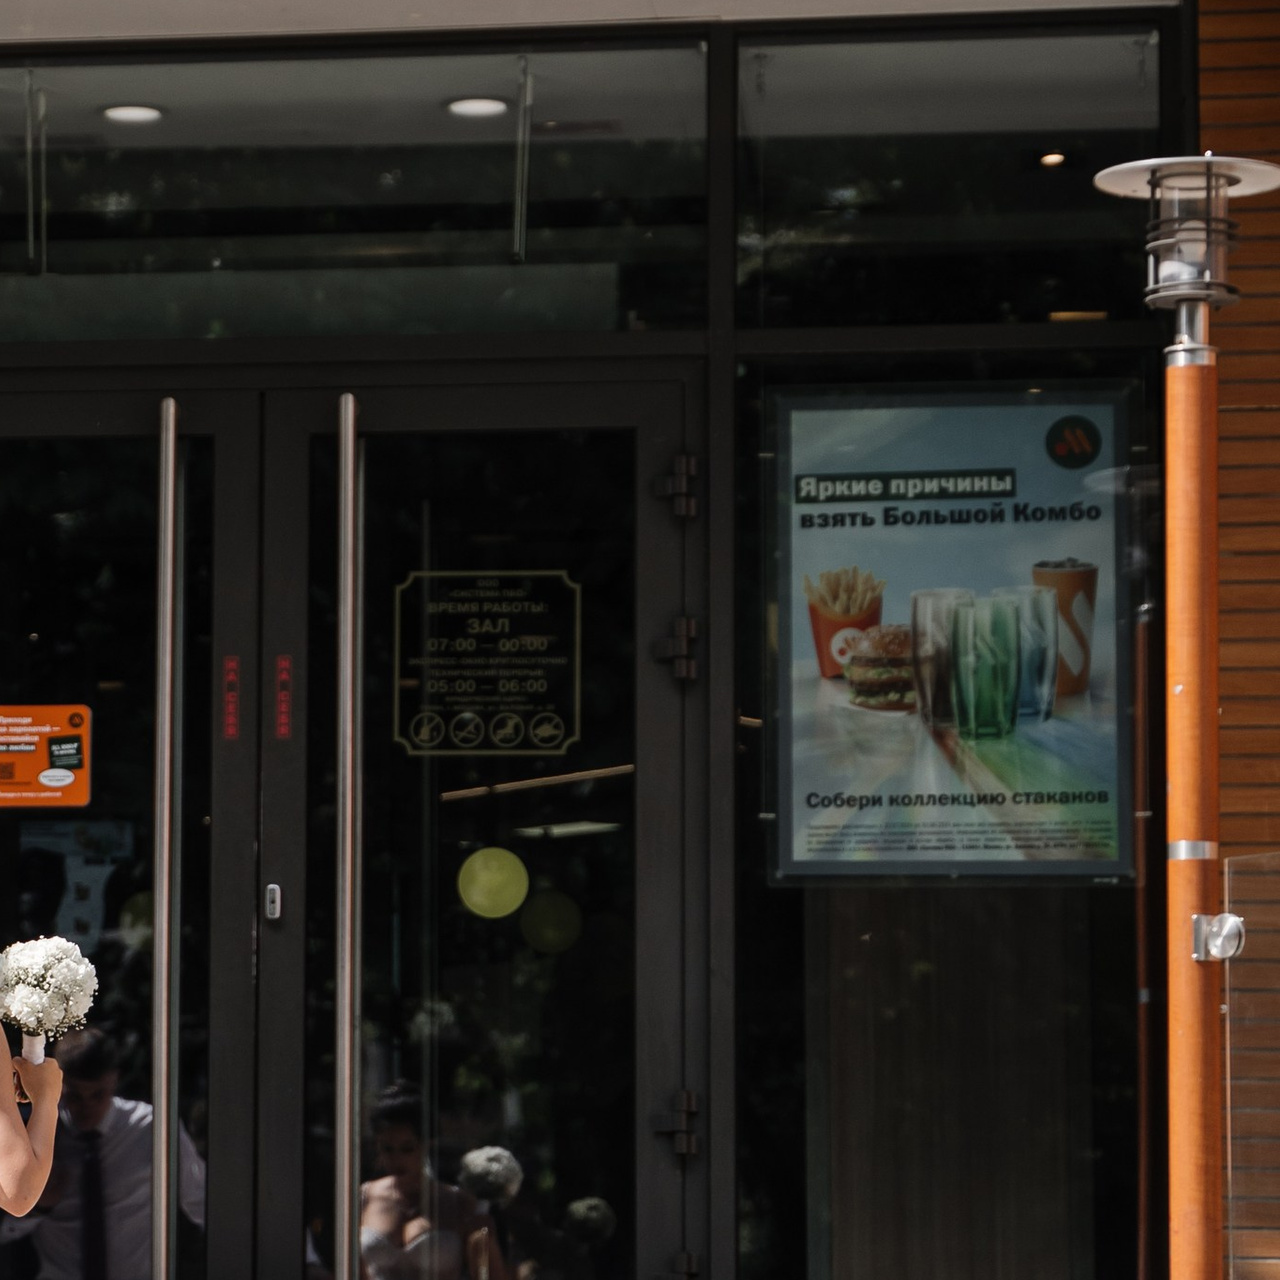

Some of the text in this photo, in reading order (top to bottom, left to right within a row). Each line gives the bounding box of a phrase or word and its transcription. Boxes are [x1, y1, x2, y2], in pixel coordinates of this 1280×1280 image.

[800, 475, 1012, 501] Яркие причины
[800, 501, 1101, 529] взять Большой Комбо
[466, 618, 510, 633] ЗАЛ
[427, 638, 477, 651] 07:00
[498, 638, 548, 651] 00:00
[427, 679, 477, 693] 05:00
[498, 679, 548, 693] 06:00
[806, 790, 1109, 810] Собери коллекцию стаканов
